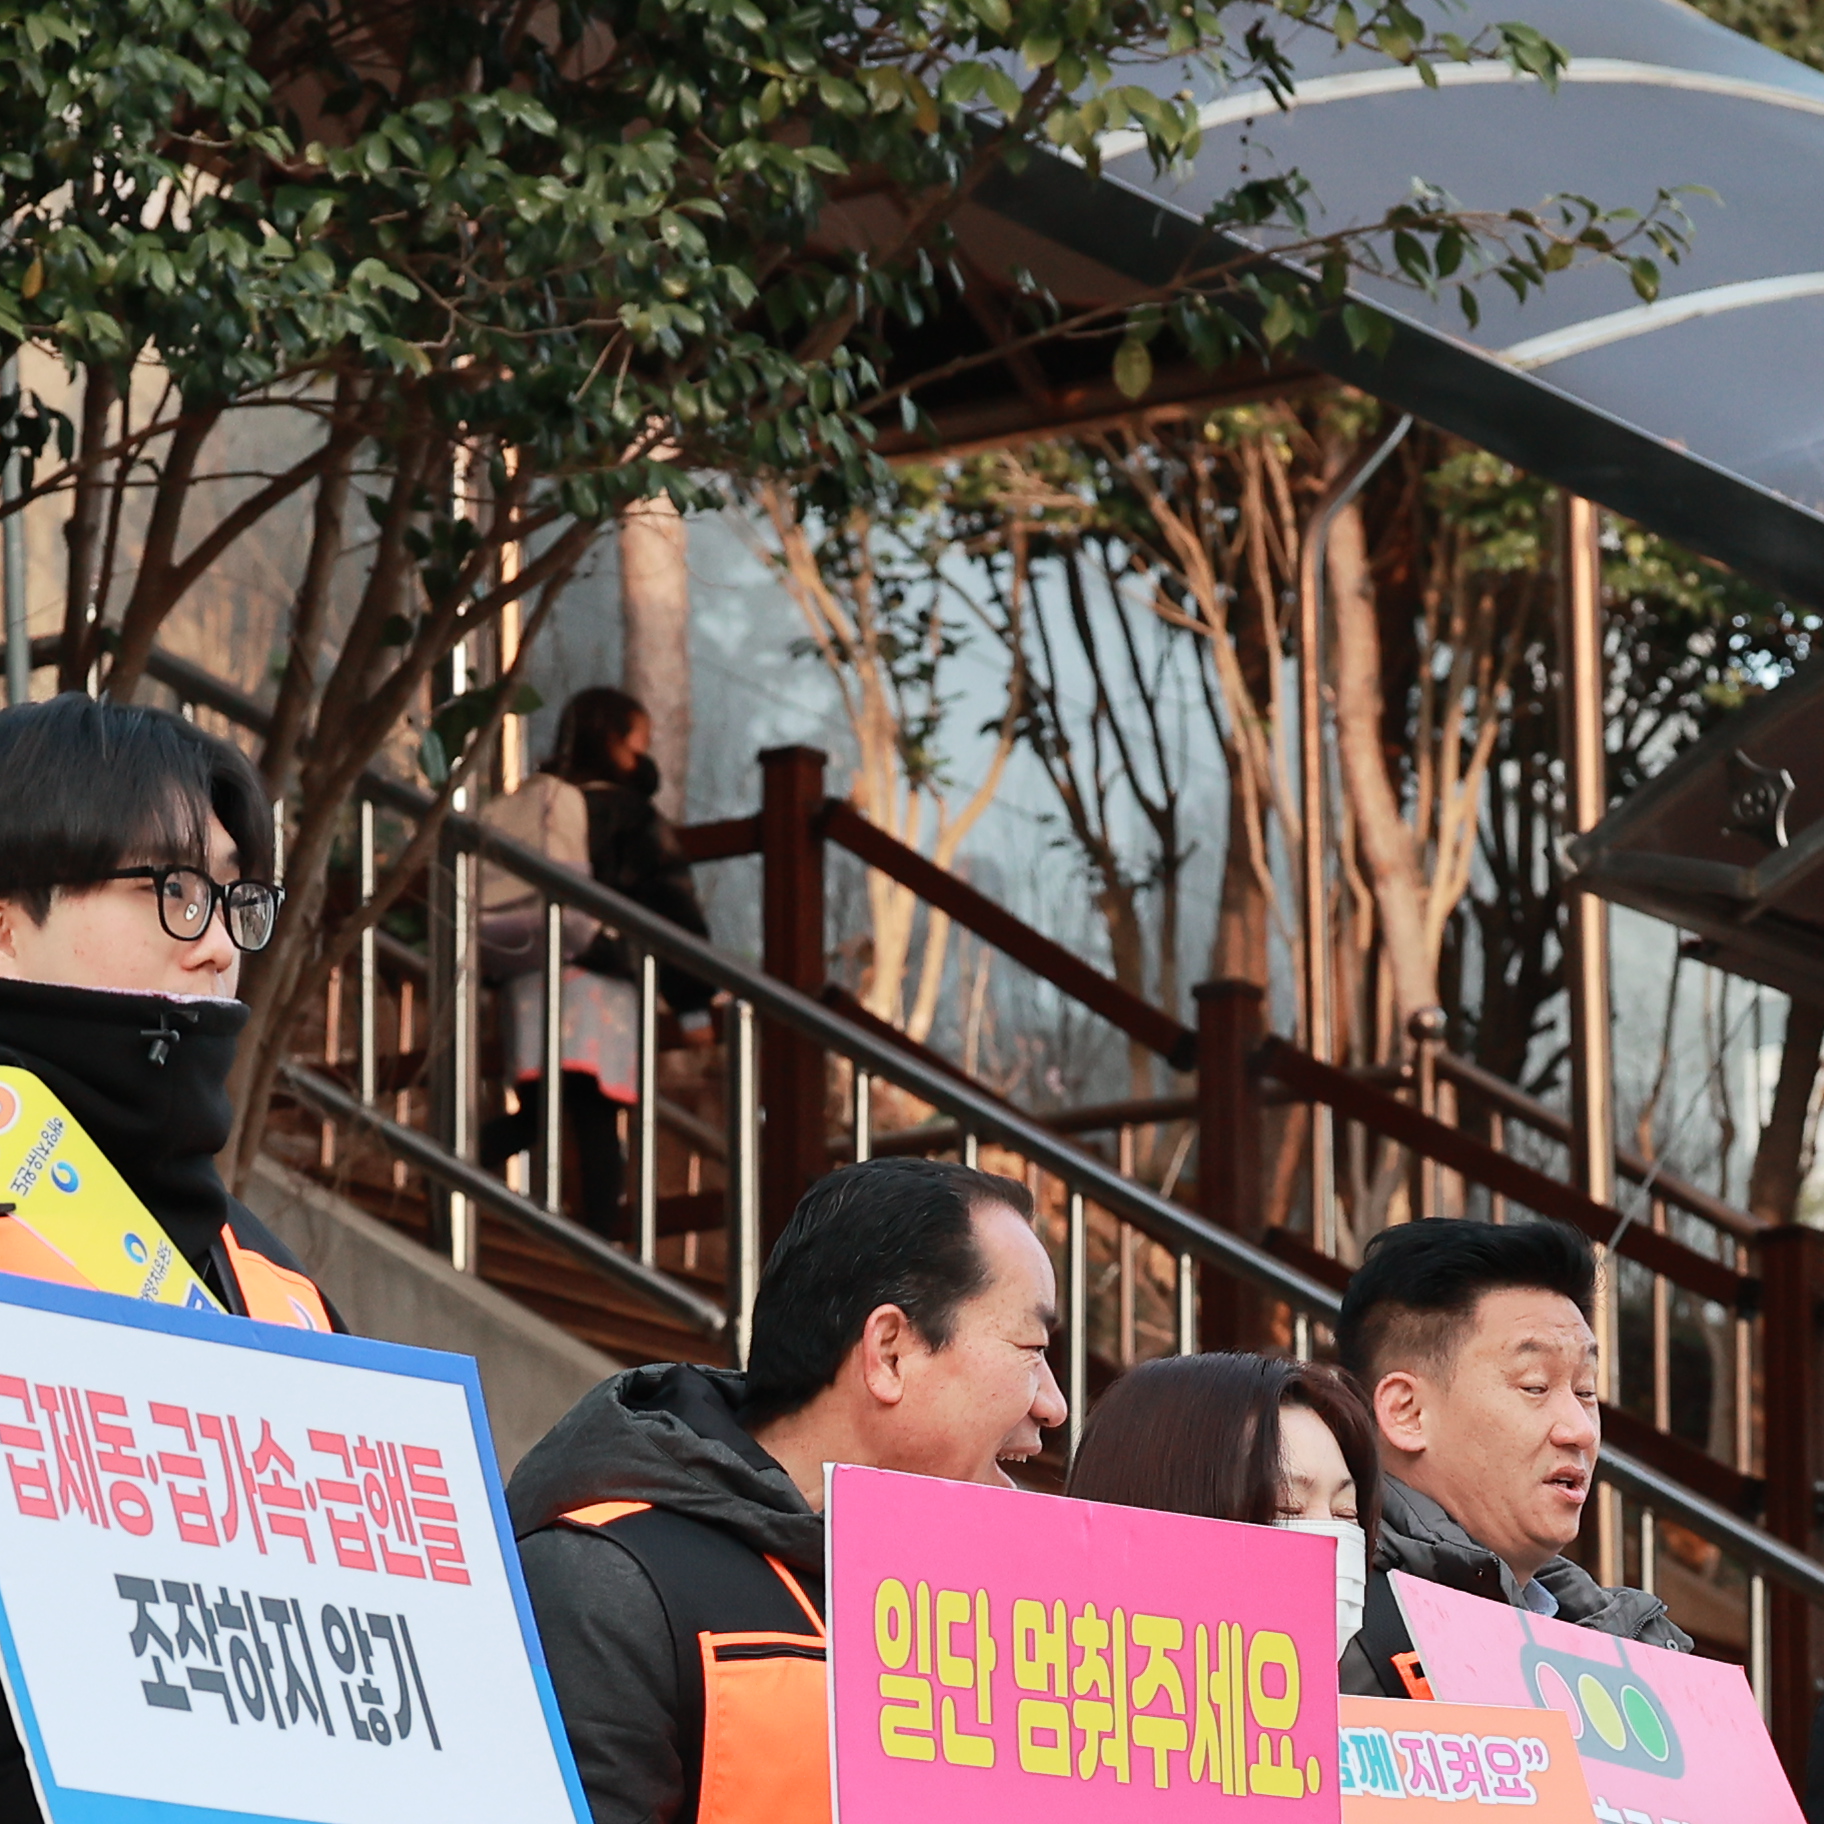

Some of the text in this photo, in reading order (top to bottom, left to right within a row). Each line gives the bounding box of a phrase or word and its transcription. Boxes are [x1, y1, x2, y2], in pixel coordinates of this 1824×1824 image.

[113, 1573, 443, 1752] 조작하지 않기
[873, 1577, 1322, 1799] 일단 멈춰주세요.
